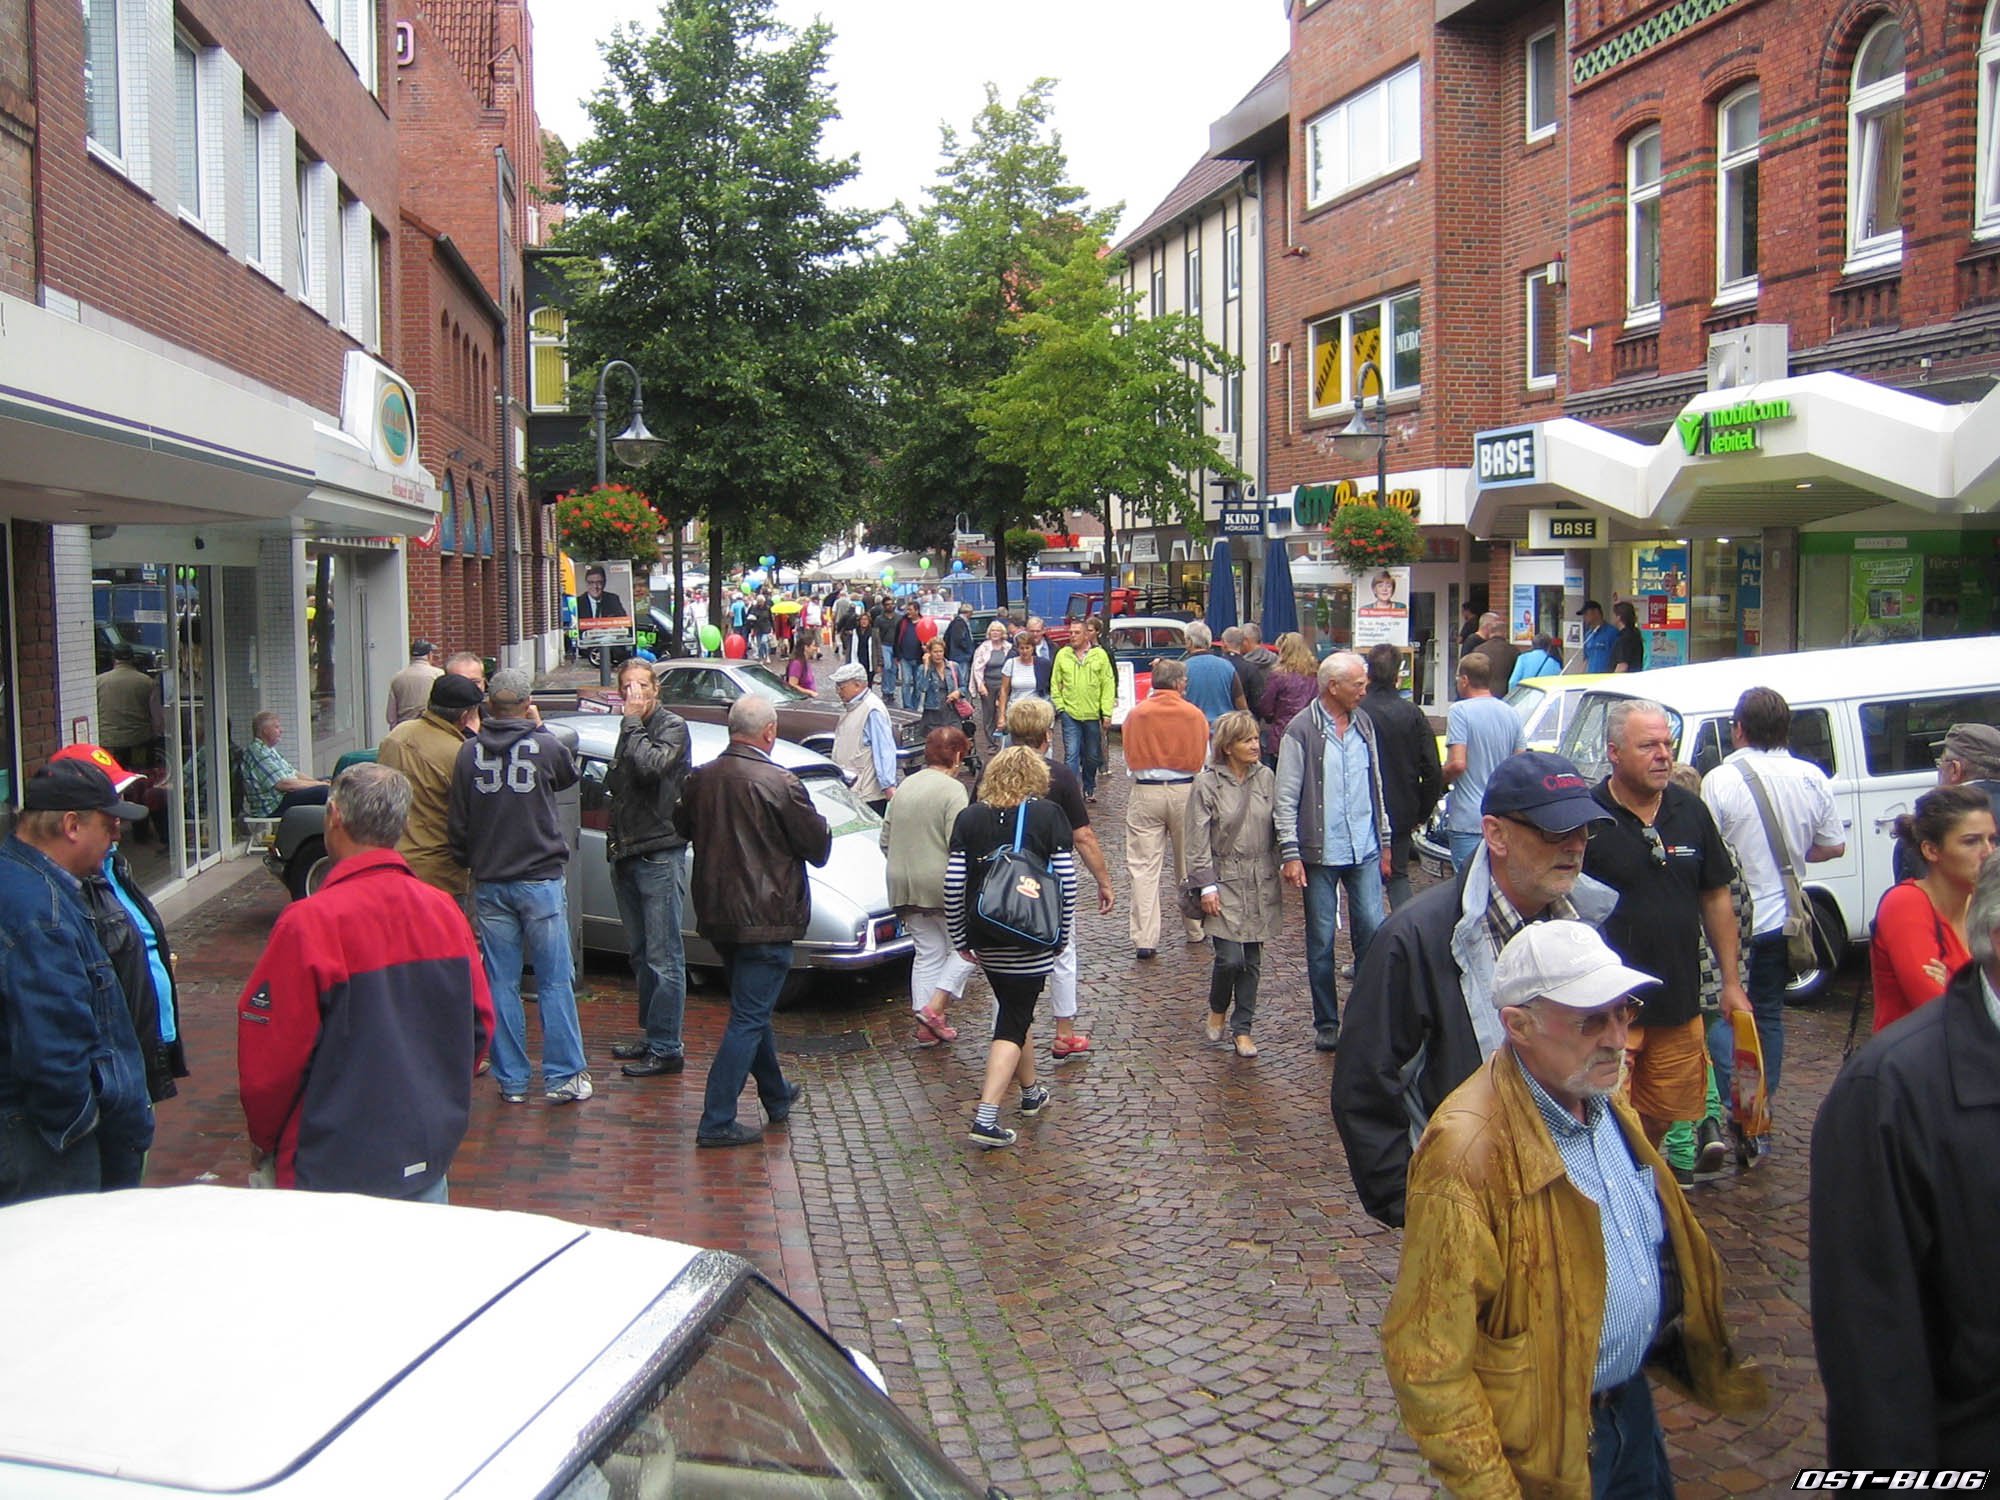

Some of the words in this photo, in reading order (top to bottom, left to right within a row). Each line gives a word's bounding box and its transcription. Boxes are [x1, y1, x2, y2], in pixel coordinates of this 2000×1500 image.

[1711, 400, 1790, 428] mobilcom
[1710, 427, 1756, 454] debitel
[1479, 437, 1532, 478] BASE
[1225, 513, 1261, 525] KIND
[1553, 522, 1594, 536] BASE
[474, 738, 540, 794] 56
